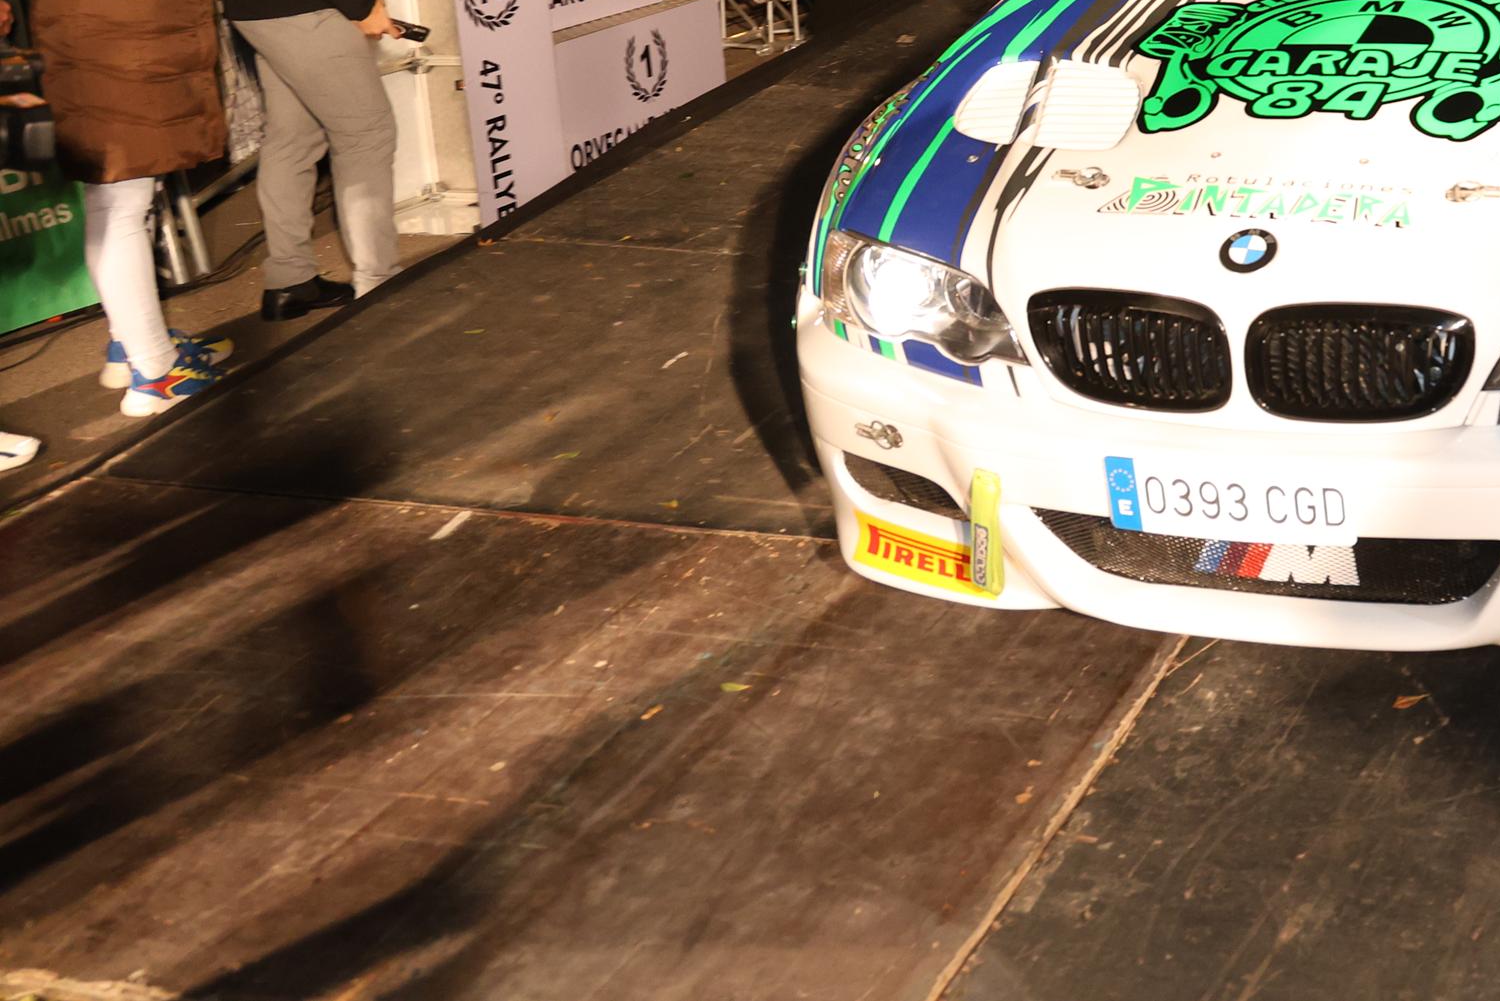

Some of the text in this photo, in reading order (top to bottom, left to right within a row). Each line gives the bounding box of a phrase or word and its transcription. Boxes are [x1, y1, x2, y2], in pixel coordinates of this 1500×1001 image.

[639, 44, 653, 78] 1
[1206, 49, 1489, 83] GARAJE
[1251, 82, 1388, 117] 84
[1185, 173, 1414, 195] Rotulaciones
[1118, 499, 1135, 516] E
[1145, 476, 1346, 526] 0393 CGD
[867, 523, 972, 583] PIRELL
